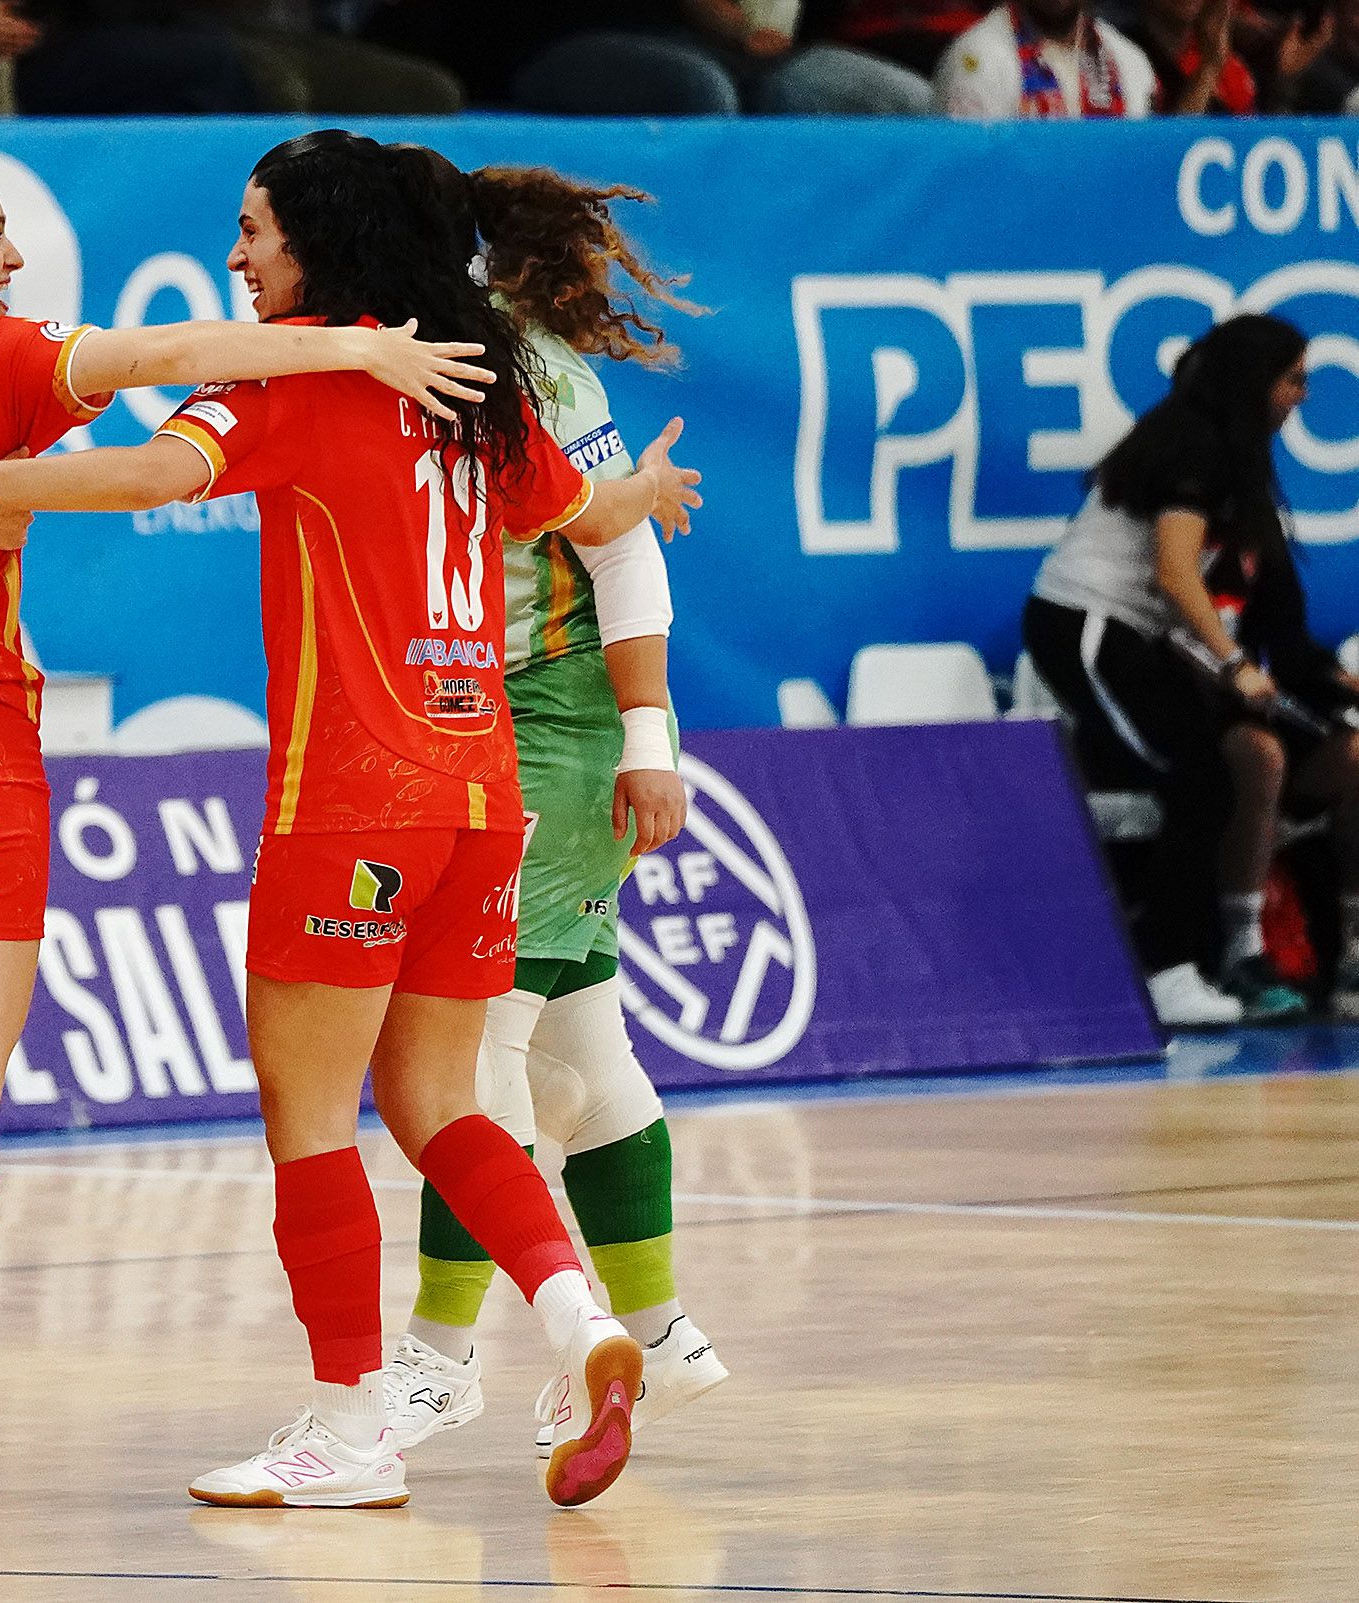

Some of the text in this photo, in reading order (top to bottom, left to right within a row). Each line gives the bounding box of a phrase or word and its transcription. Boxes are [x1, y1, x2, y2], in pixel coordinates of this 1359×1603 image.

[405, 637, 499, 669] ABANCA
[636, 851, 720, 907] RF
[650, 911, 738, 968] EF
